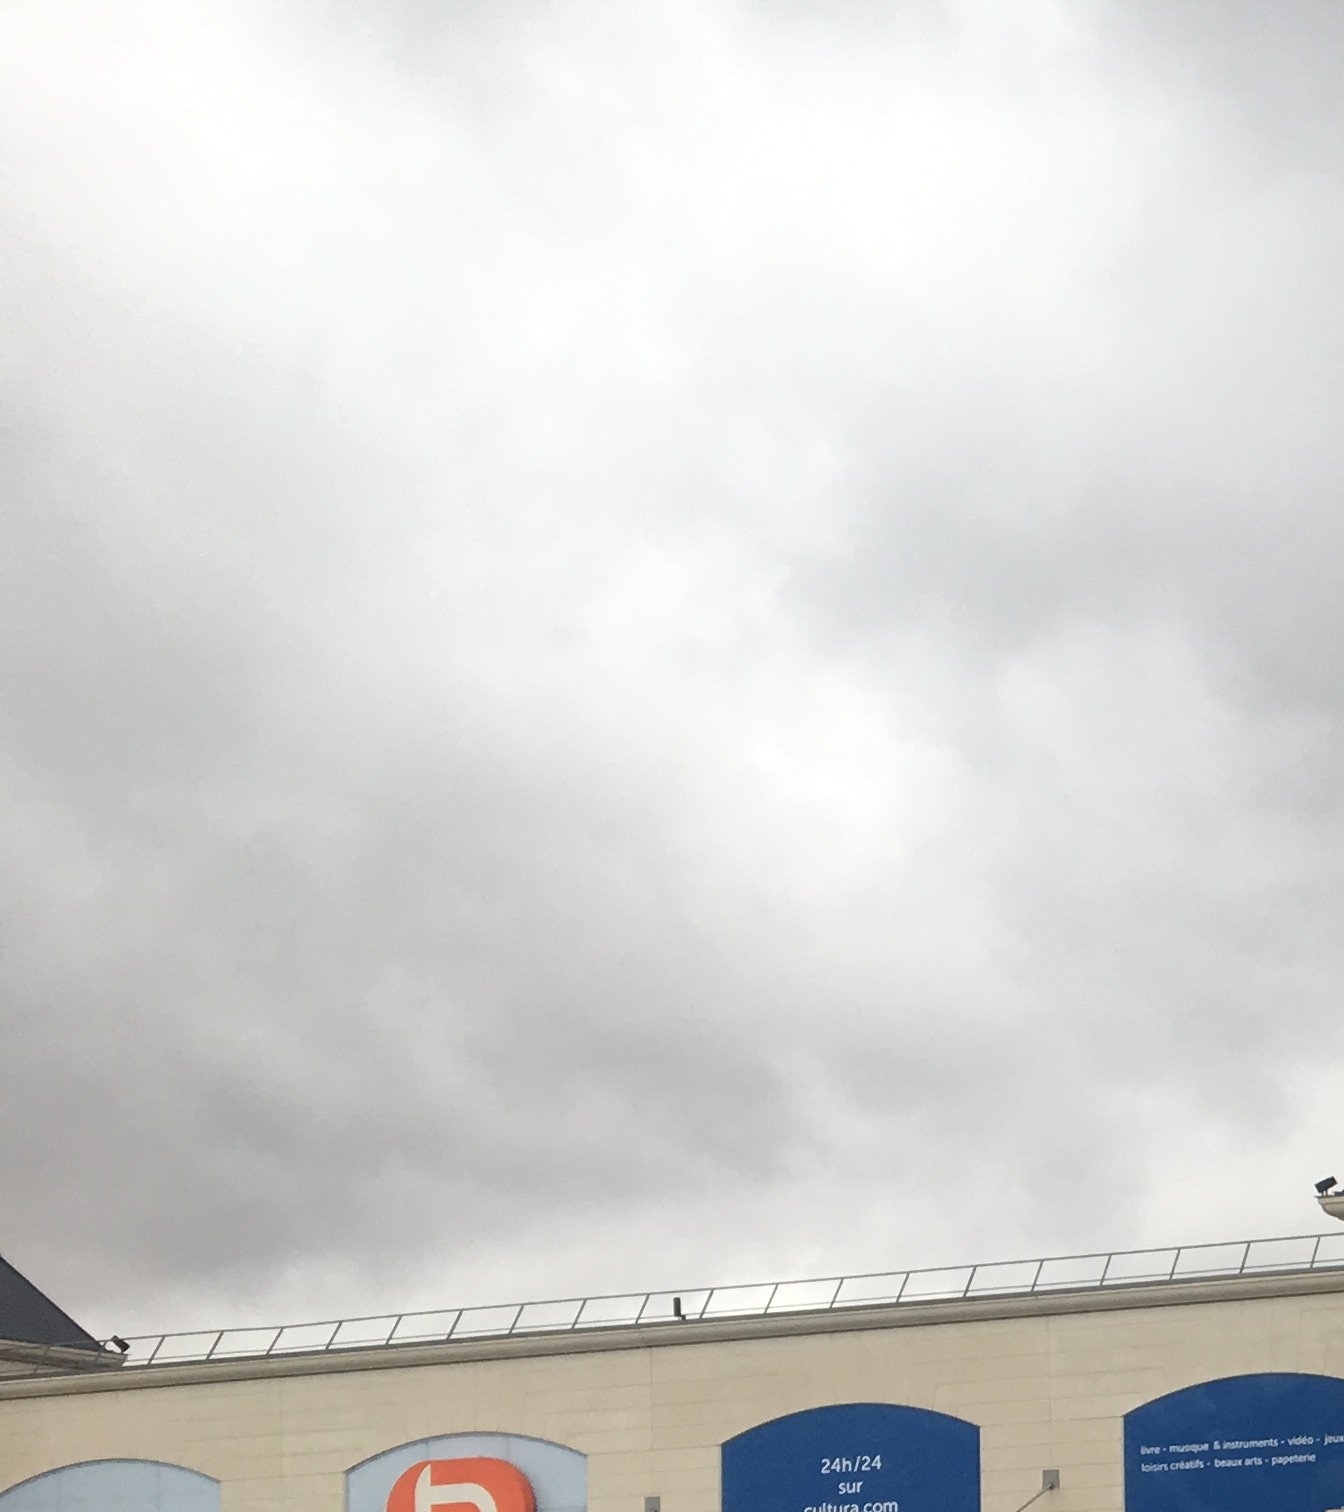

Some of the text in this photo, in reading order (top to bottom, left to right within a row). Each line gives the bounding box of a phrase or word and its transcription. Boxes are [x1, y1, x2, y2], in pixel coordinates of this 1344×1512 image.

[1140, 1445, 1161, 1456] livre
[1169, 1442, 1210, 1455] musique
[1222, 1437, 1279, 1450] instruments
[1287, 1433, 1315, 1446] vidéo
[820, 1454, 883, 1474] 24h/24
[1140, 1462, 1169, 1473] loisirs
[1169, 1459, 1205, 1471] créatifs
[1213, 1457, 1243, 1469] beaux
[1244, 1456, 1263, 1467] arts
[1271, 1452, 1317, 1466] papeterie
[838, 1480, 864, 1495] sur
